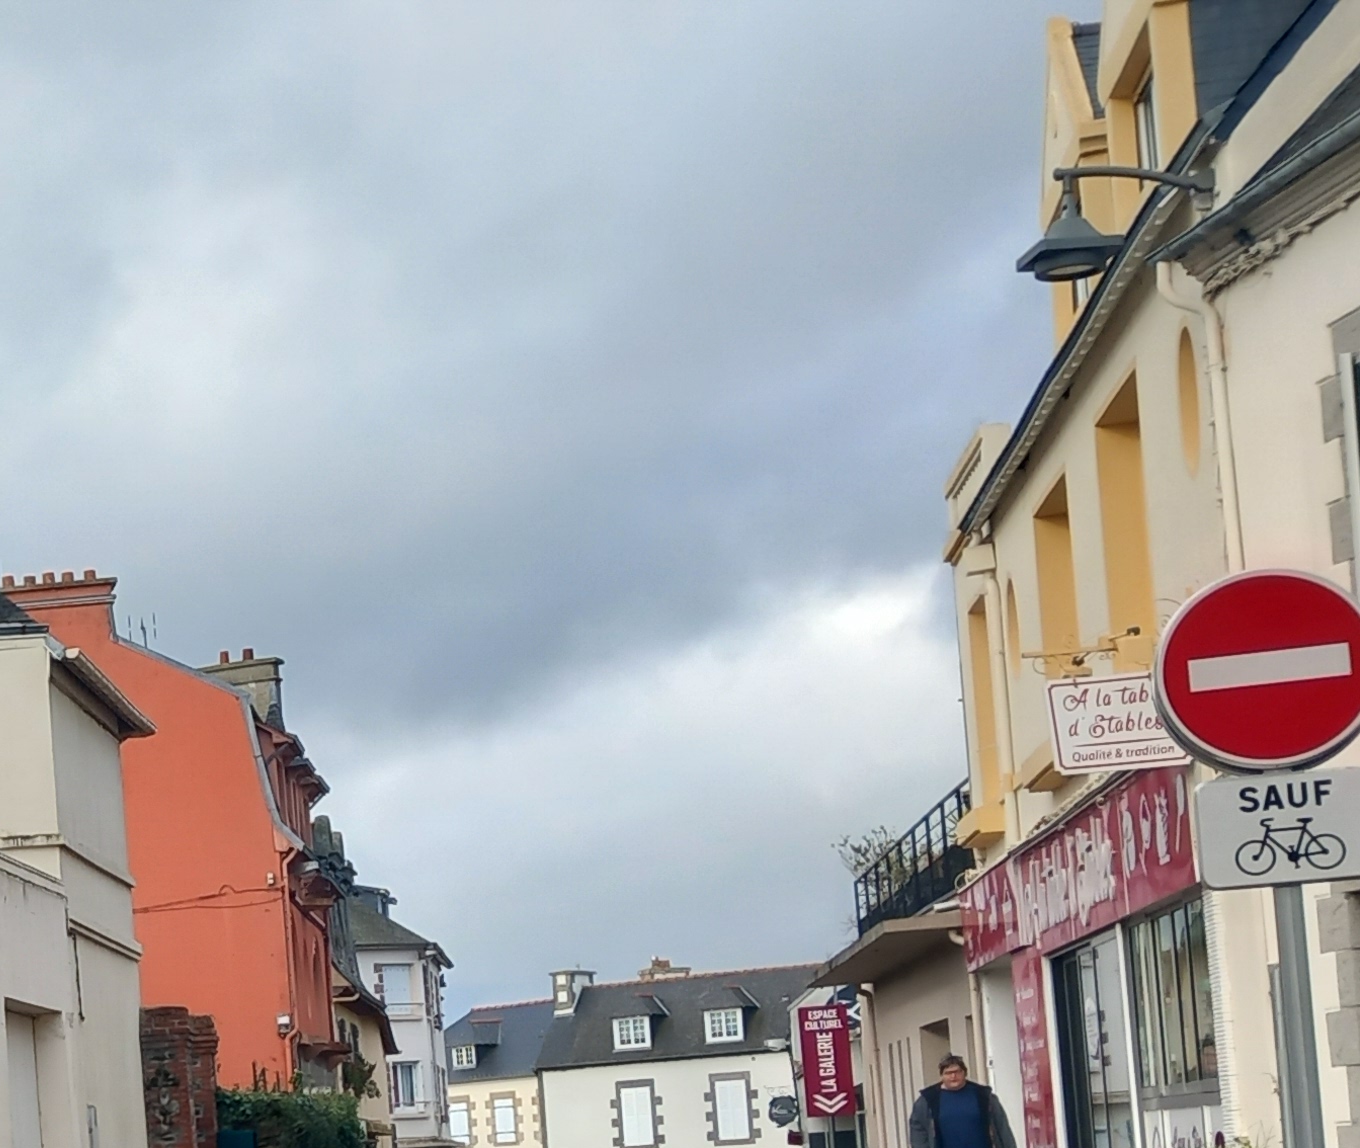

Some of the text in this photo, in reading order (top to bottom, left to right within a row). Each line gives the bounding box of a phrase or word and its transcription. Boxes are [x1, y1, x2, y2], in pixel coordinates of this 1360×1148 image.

[1063, 682, 1149, 711] A la tab
[1072, 745, 1175, 762] Qualité & tradition
[1239, 779, 1333, 812] SAUF
[804, 1019, 843, 1031] CULTUREL
[807, 1008, 838, 1020] ESPACE
[816, 1031, 838, 1093] LA GALERIE
